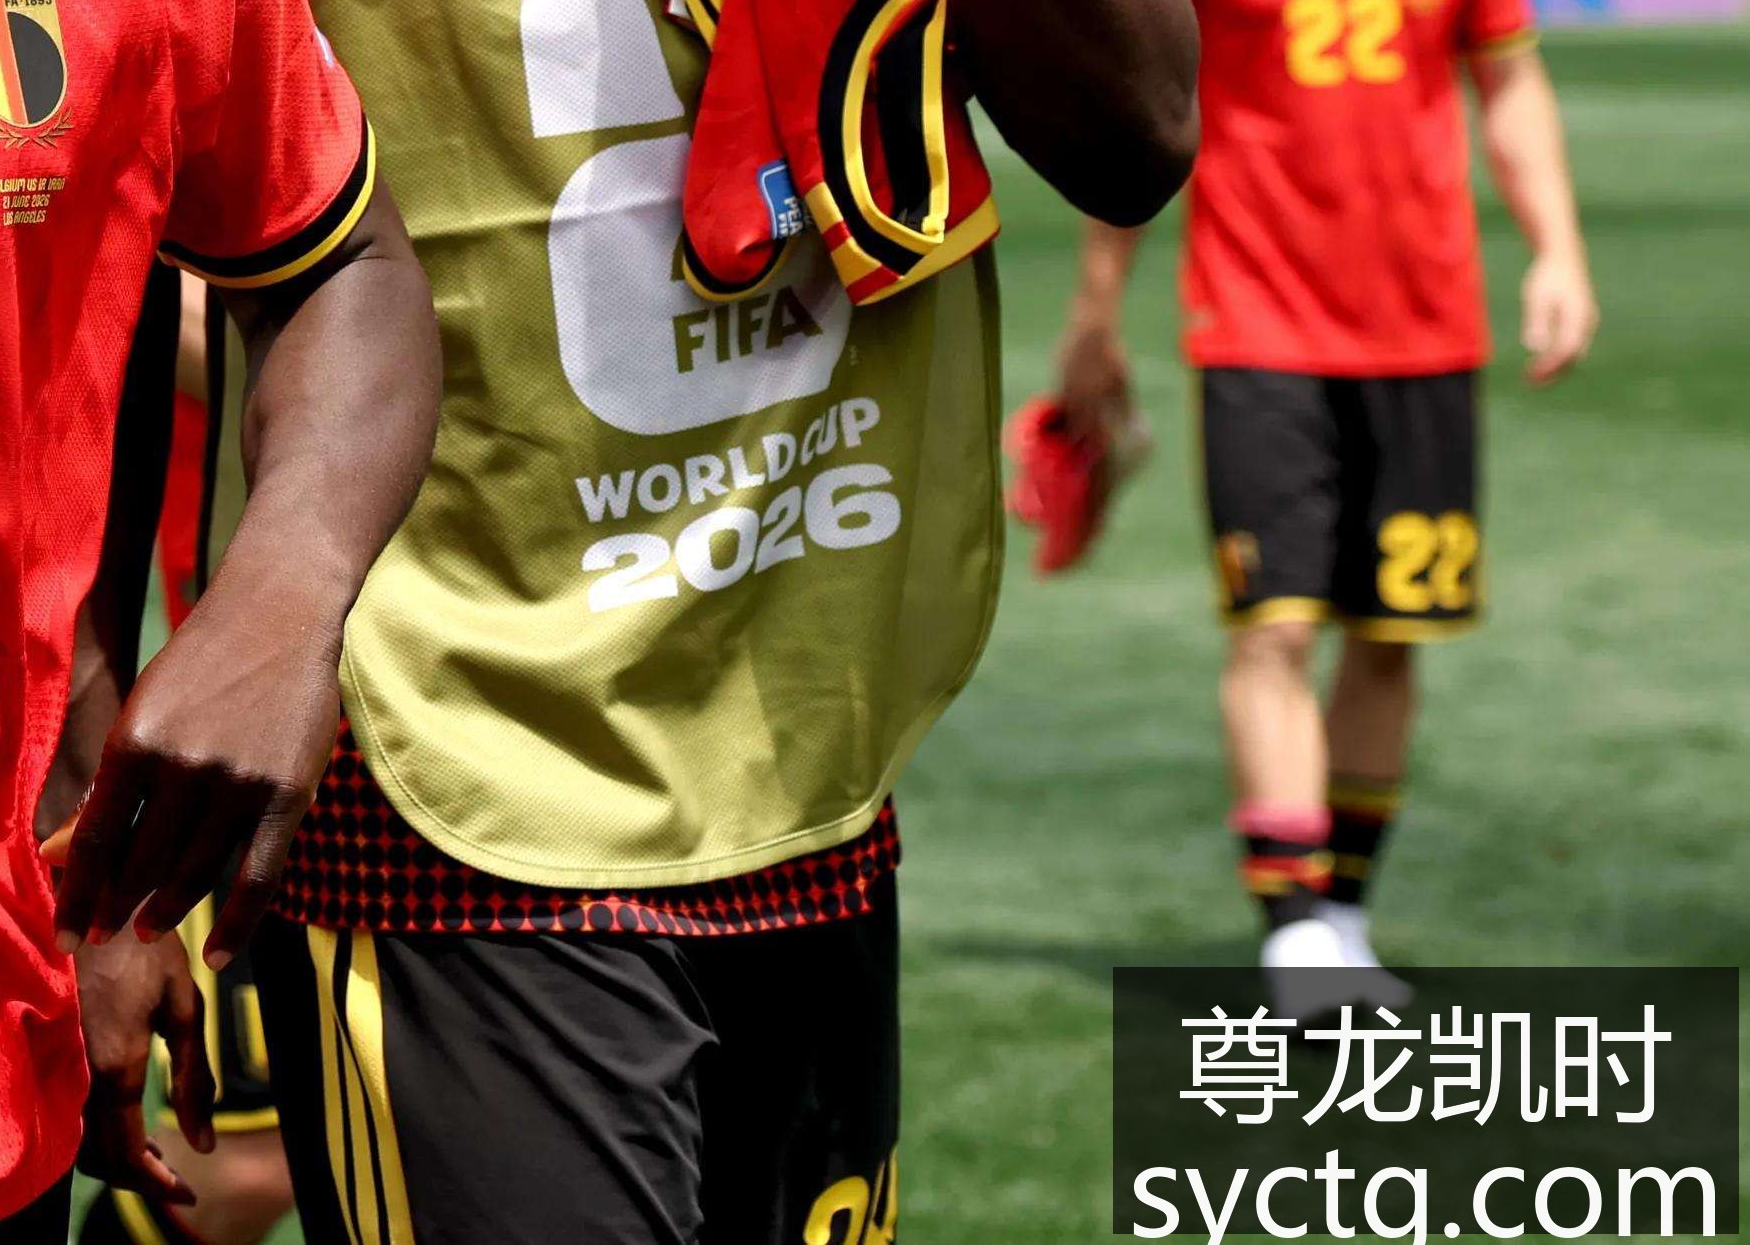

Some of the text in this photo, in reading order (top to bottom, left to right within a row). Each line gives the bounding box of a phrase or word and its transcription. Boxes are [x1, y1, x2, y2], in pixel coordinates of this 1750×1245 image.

[672, 287, 824, 374] FIFA
[575, 397, 881, 523] WORLD CUP
[582, 463, 902, 614] 2026
[1376, 512, 1479, 612] 22
